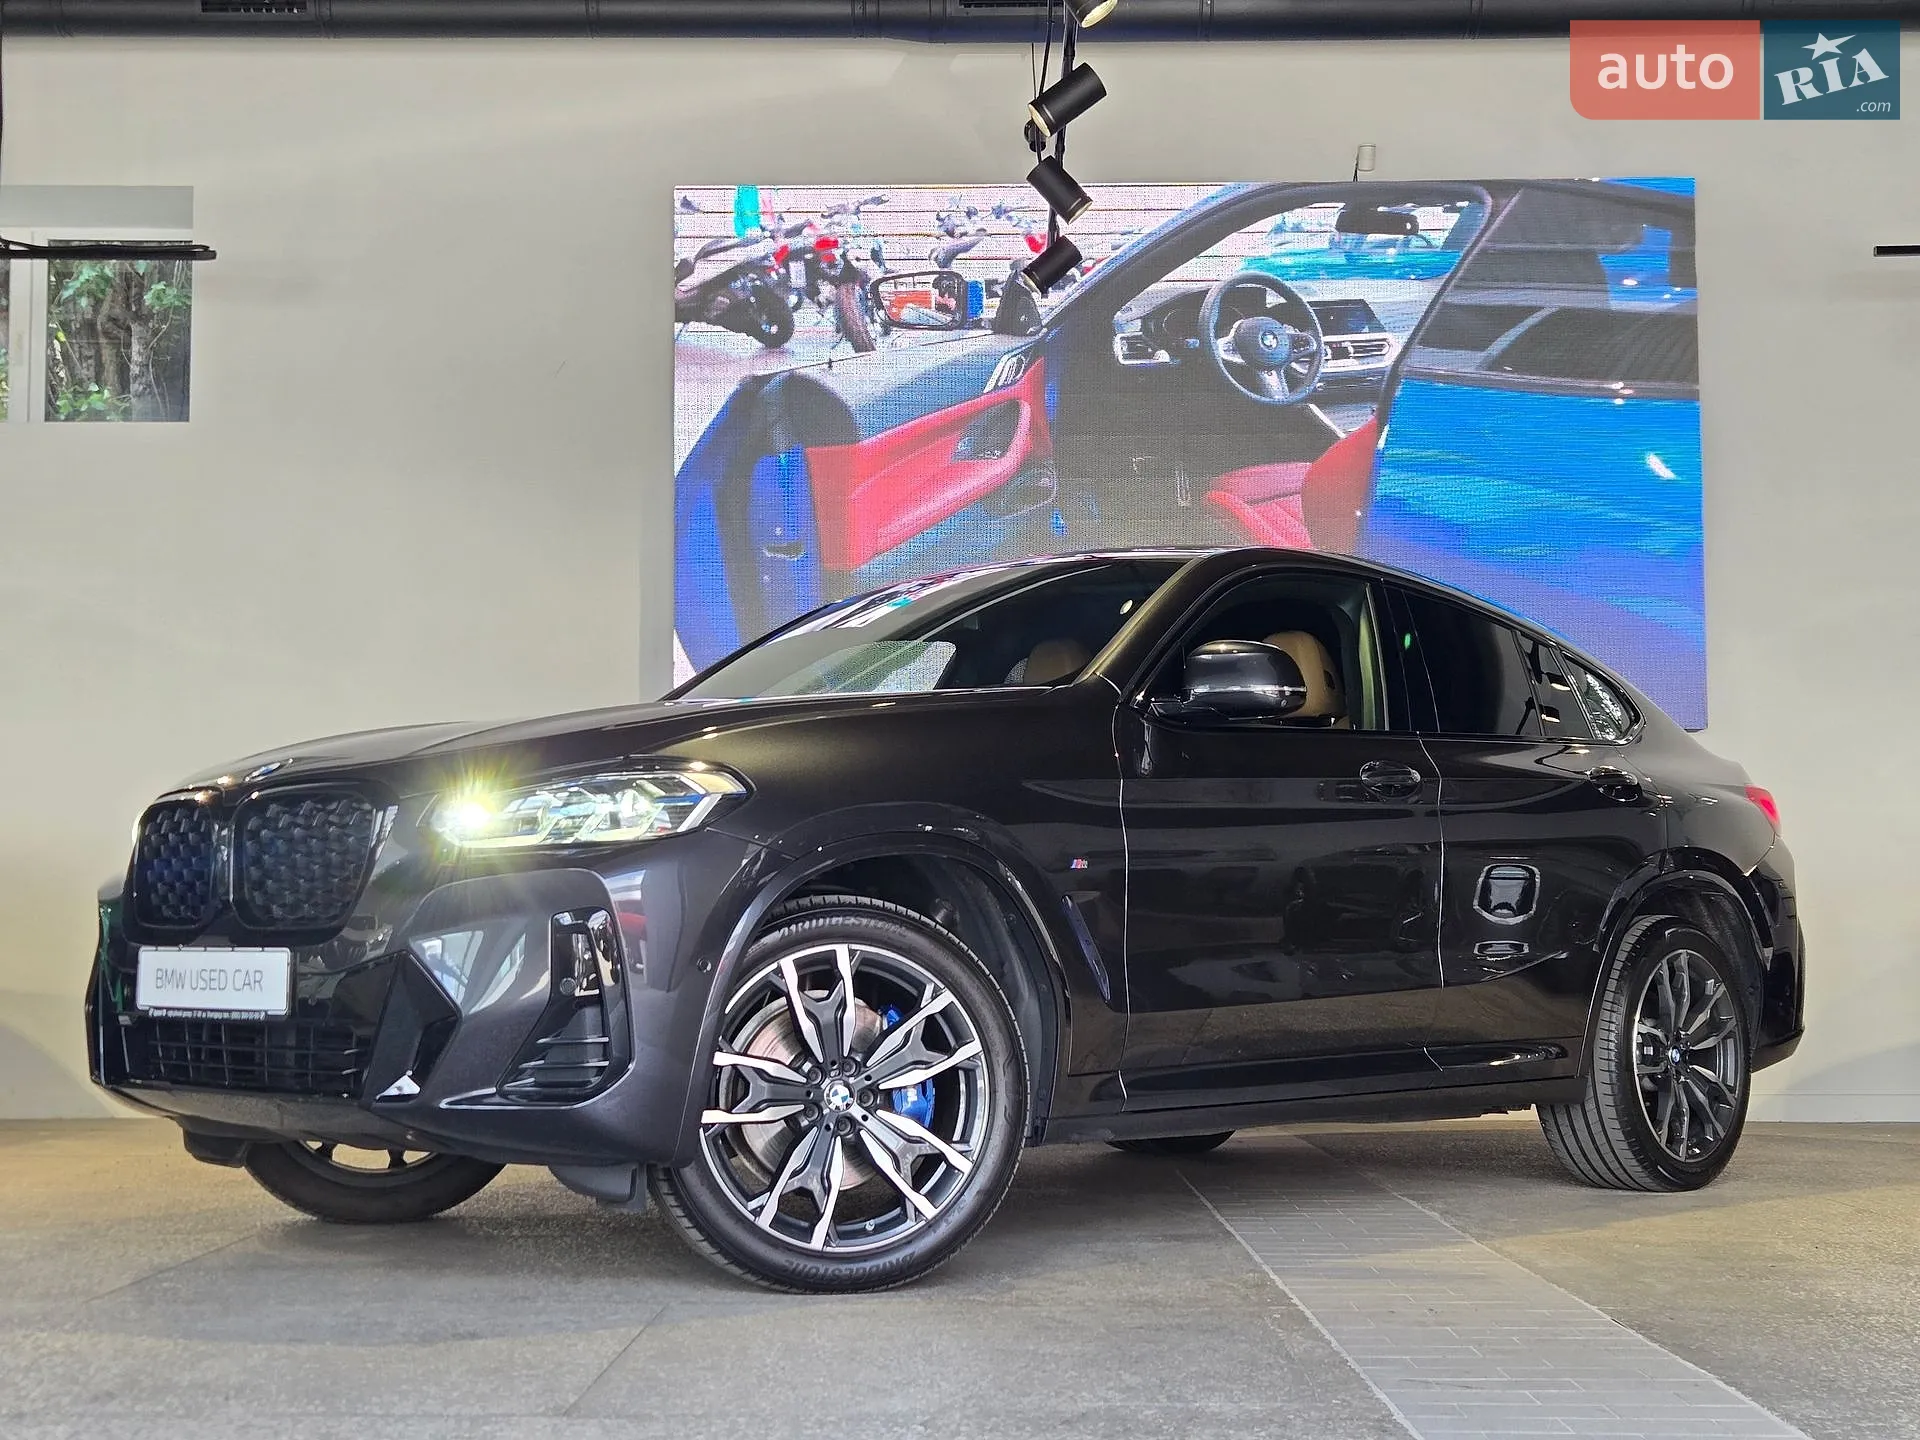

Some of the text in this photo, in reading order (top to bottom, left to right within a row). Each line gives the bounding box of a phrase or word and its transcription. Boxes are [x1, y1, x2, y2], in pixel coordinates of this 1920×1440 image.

[155, 968, 264, 992] BMW USED CAR
